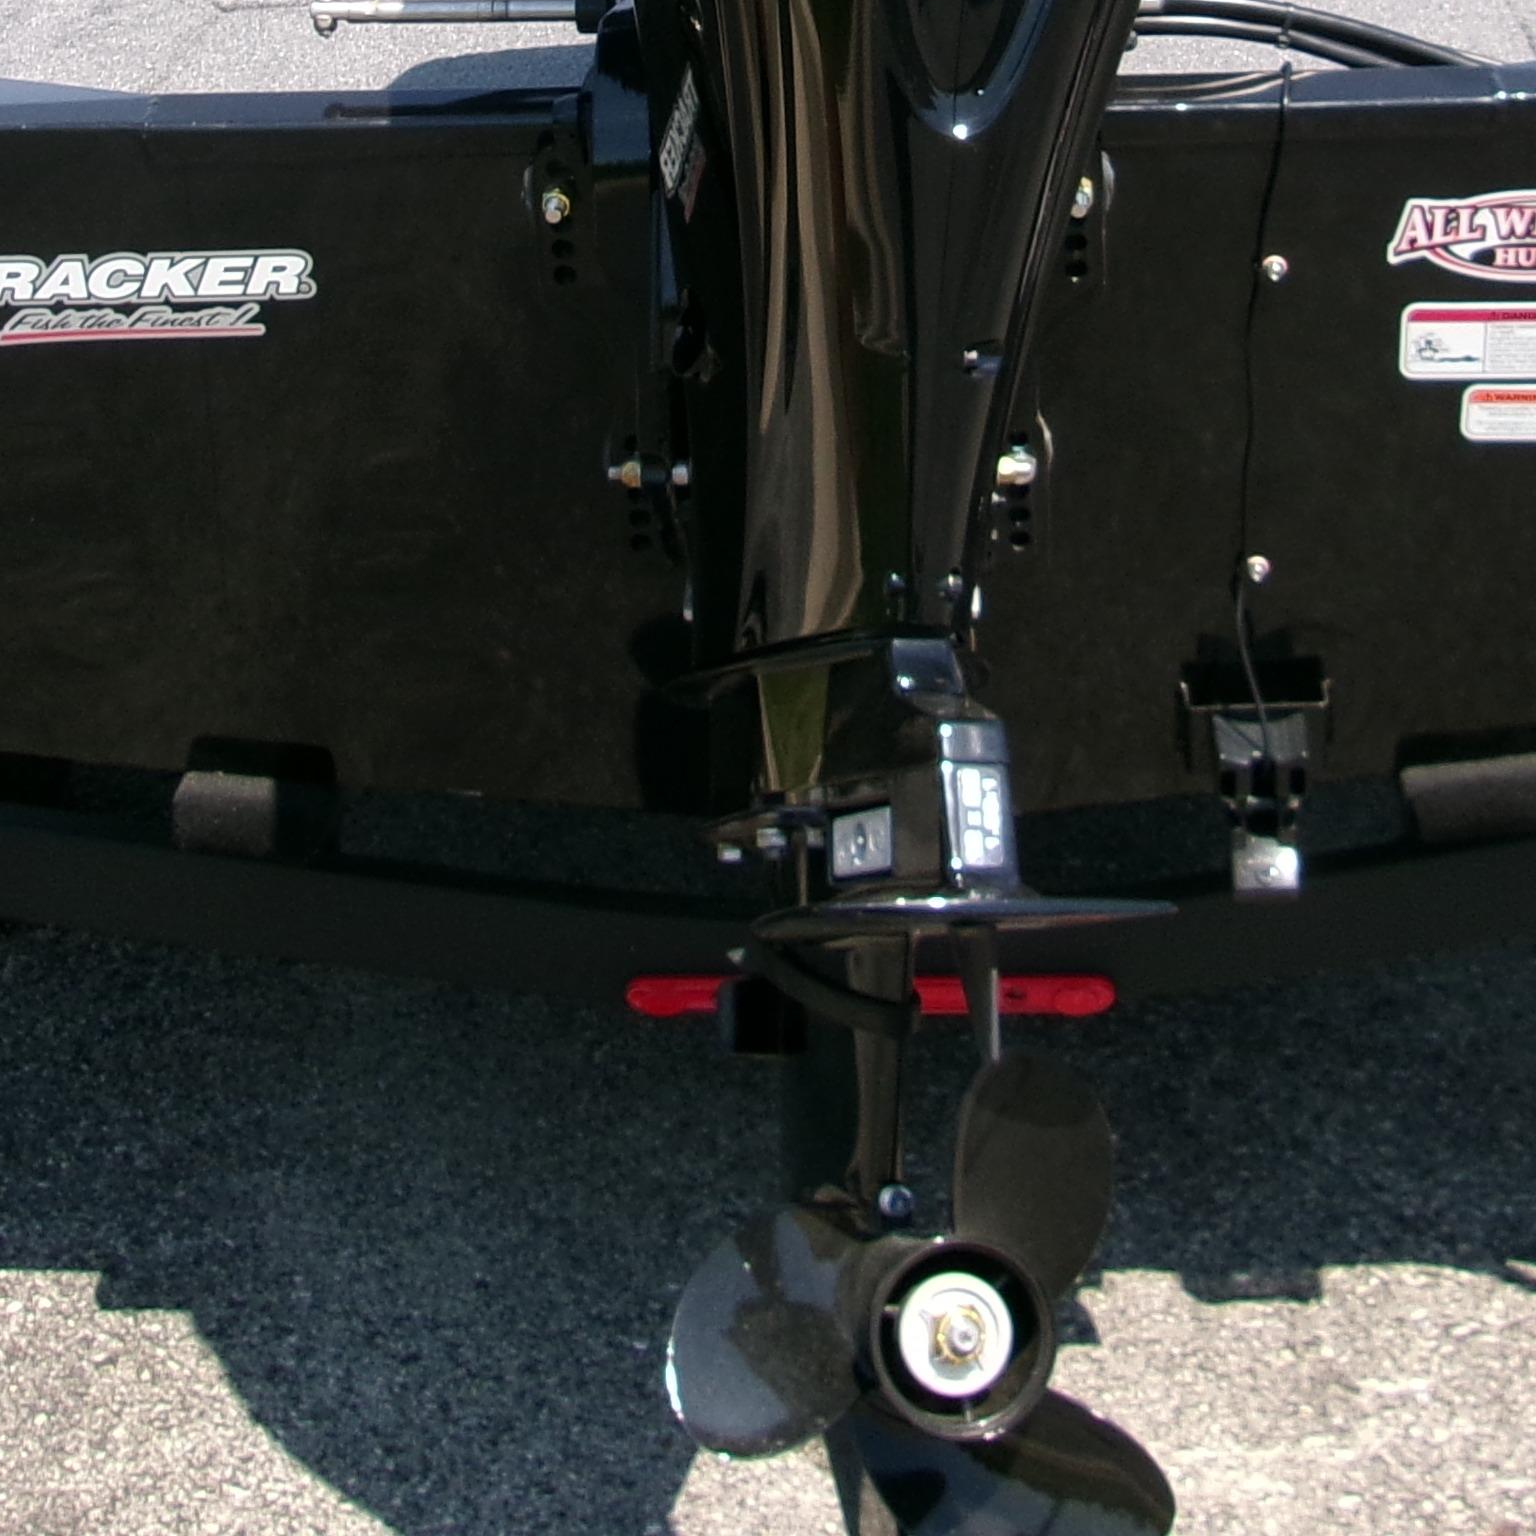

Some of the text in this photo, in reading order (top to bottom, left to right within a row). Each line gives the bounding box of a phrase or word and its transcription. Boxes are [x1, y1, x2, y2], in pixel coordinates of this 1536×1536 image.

[1392, 204, 1487, 254] ALL
[10, 311, 70, 331] Fish
[76, 312, 123, 329] the
